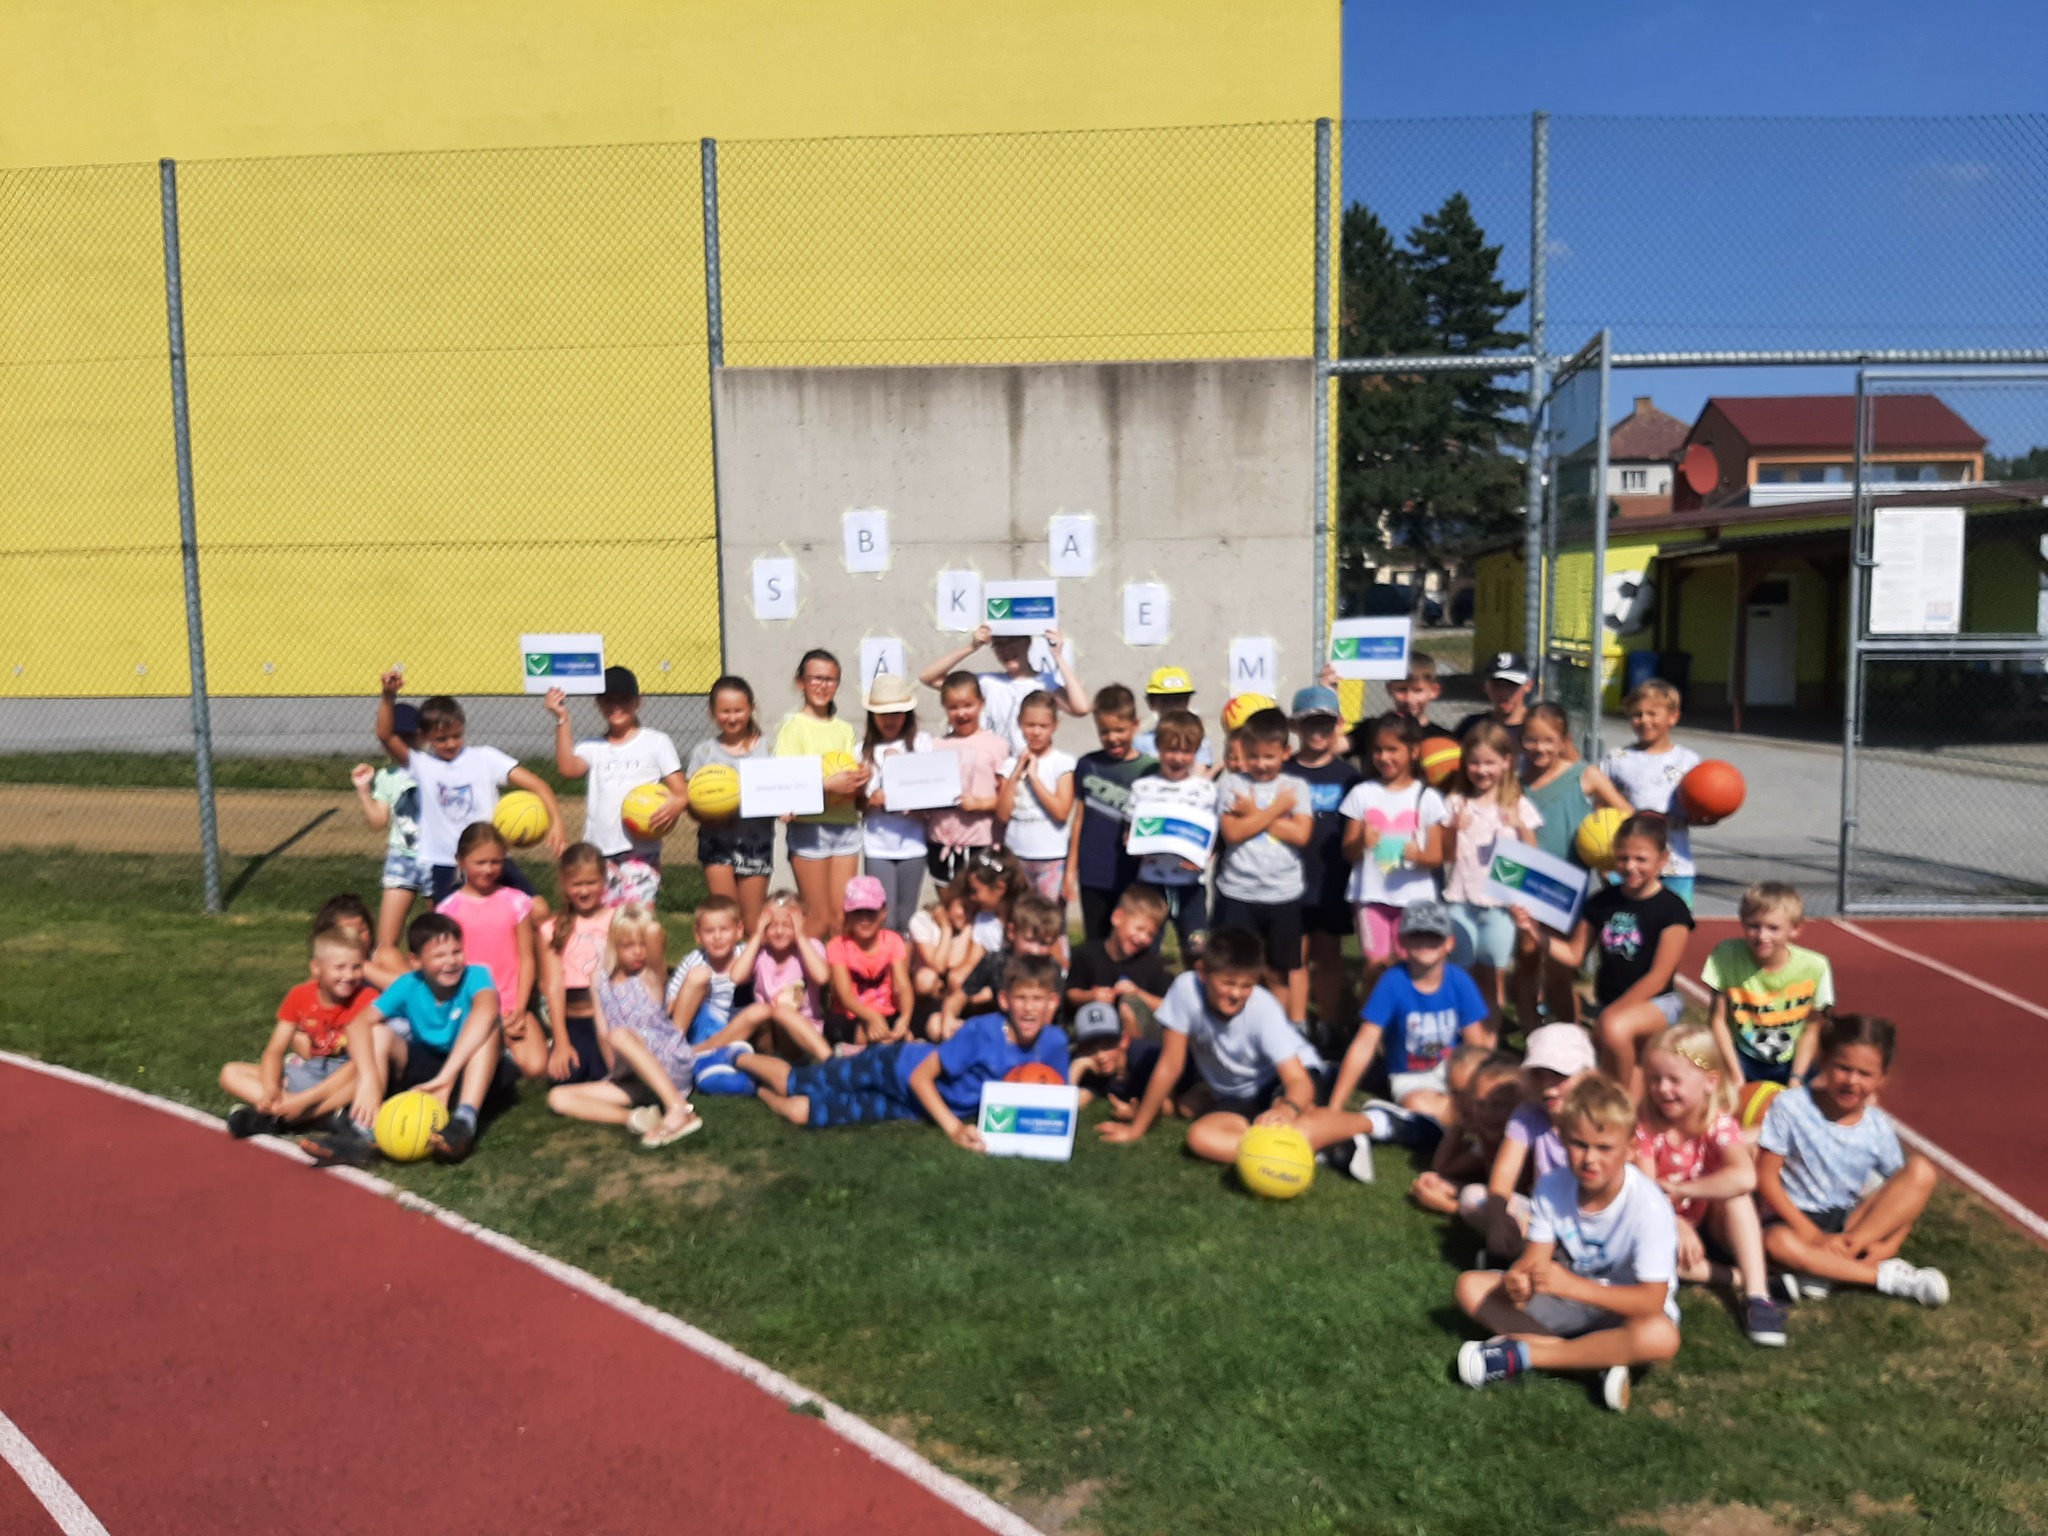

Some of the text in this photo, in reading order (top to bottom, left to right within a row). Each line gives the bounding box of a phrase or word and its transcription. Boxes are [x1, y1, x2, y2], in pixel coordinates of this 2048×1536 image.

[859, 529, 875, 553] B
[1062, 534, 1081, 557] A
[767, 577, 781, 602] S
[951, 589, 967, 612] K
[1139, 602, 1151, 626] E
[1238, 656, 1265, 679] M
